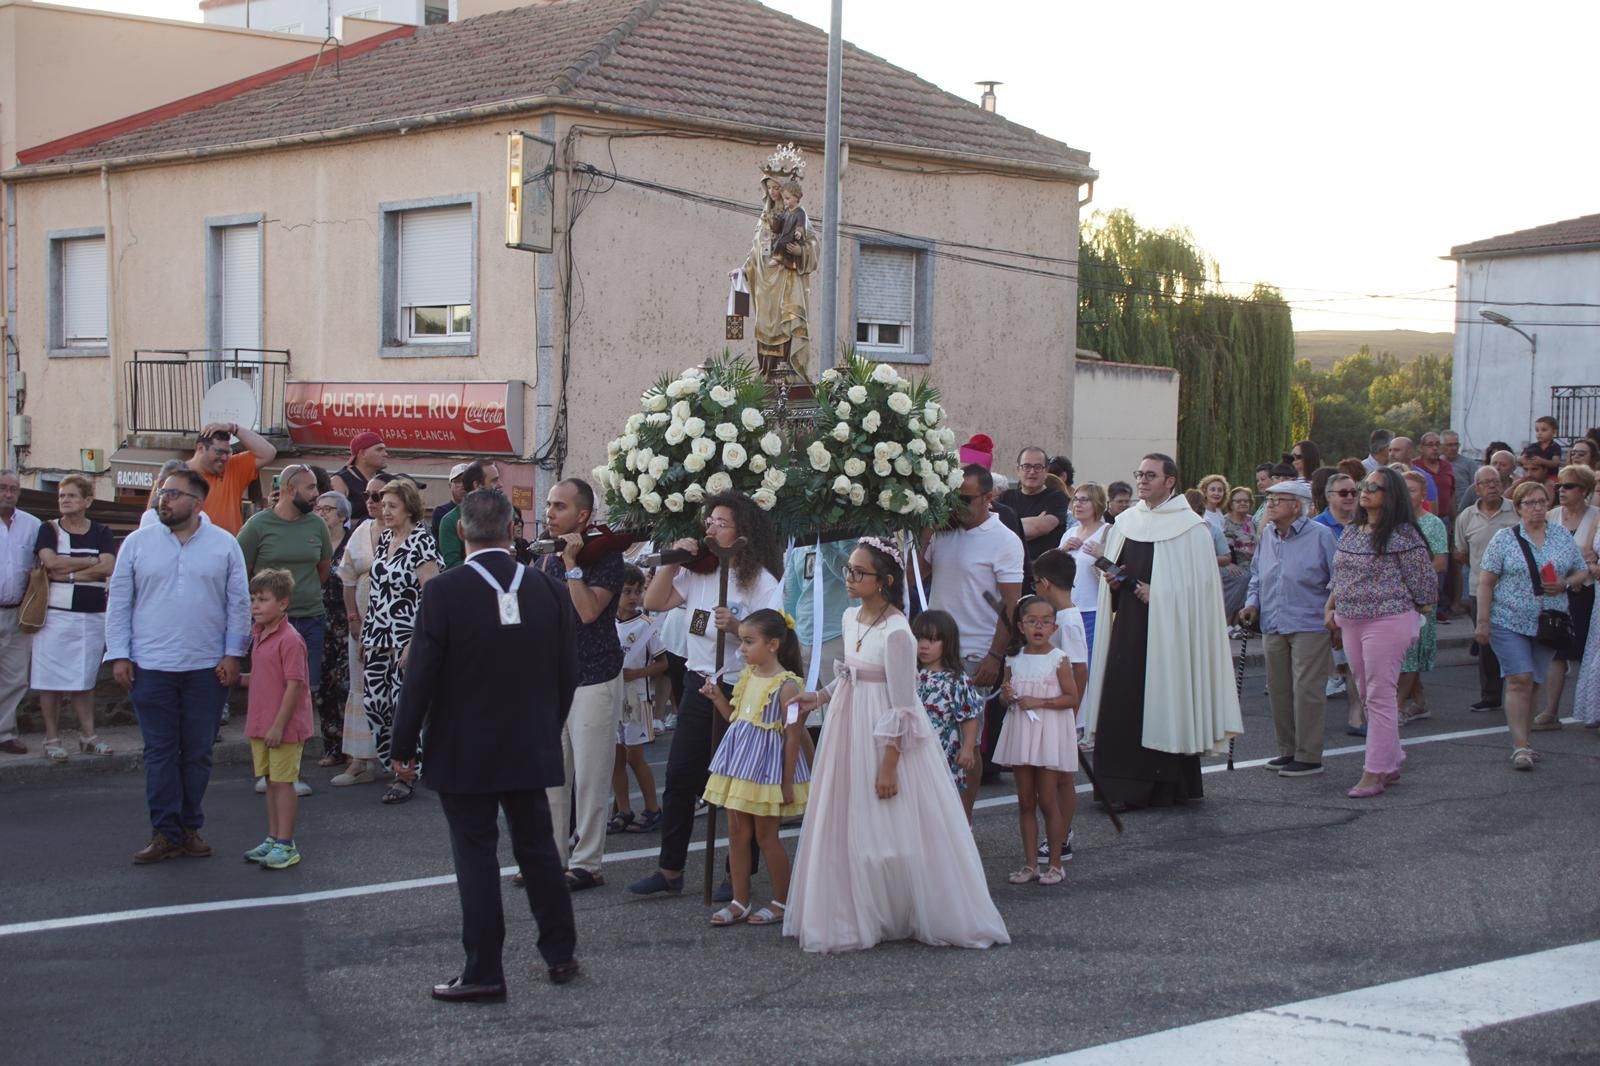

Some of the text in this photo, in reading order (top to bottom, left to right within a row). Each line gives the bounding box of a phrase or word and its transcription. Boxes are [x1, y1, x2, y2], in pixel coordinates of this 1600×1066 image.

[323, 392, 460, 420] PUERTA DEL RIO
[379, 428, 408, 440] TAPAS
[415, 430, 456, 441] PLANCHA
[117, 471, 153, 487] RACIONES
